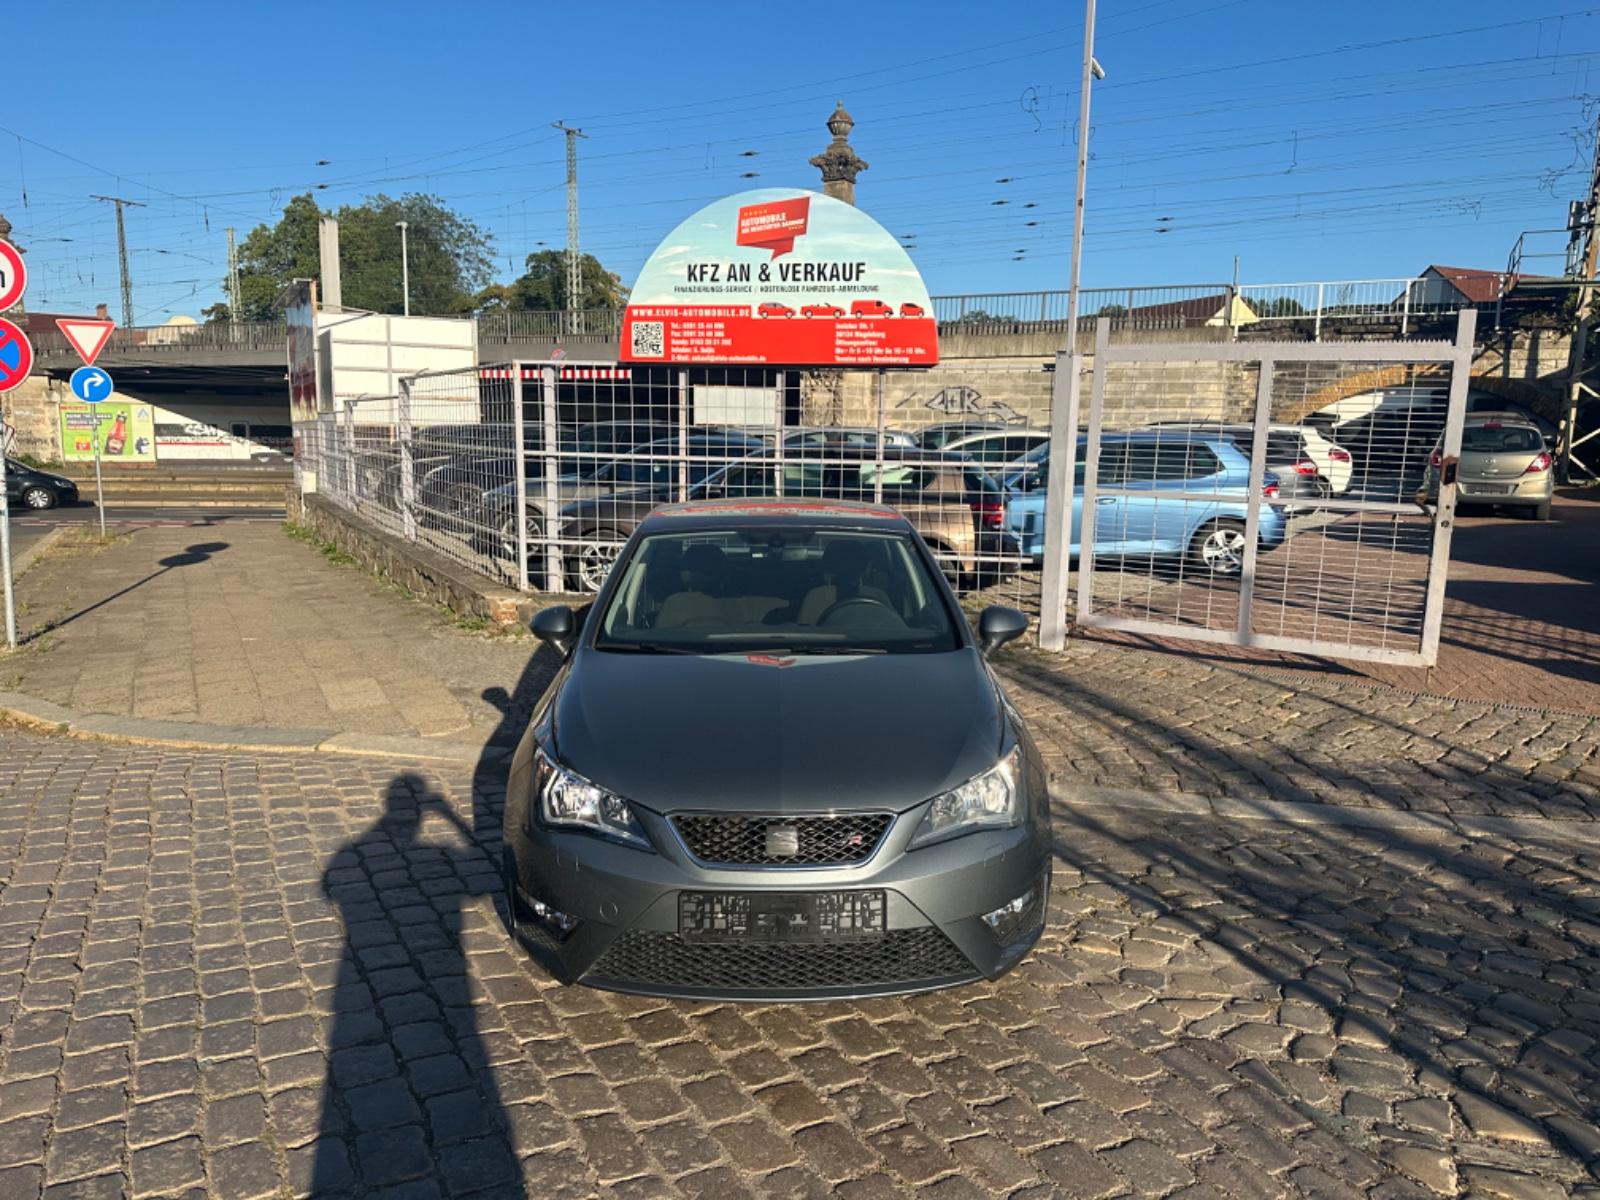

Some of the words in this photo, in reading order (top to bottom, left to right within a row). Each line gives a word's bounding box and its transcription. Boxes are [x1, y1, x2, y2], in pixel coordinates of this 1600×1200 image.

[741, 212, 787, 227] AUTOMOBILE
[687, 264, 720, 282] KFZ
[727, 263, 750, 282] AN
[758, 263, 771, 282] &
[779, 262, 866, 282] VERKAUF
[674, 285, 752, 293] FINANZIERUNGS-SERVICE
[760, 285, 799, 293] KOSTENLOSE
[802, 284, 879, 293] FAHRZEUG-ABMELDUNG
[632, 308, 750, 317] WWW.ELVIS-AUTOMOBILE.DE
